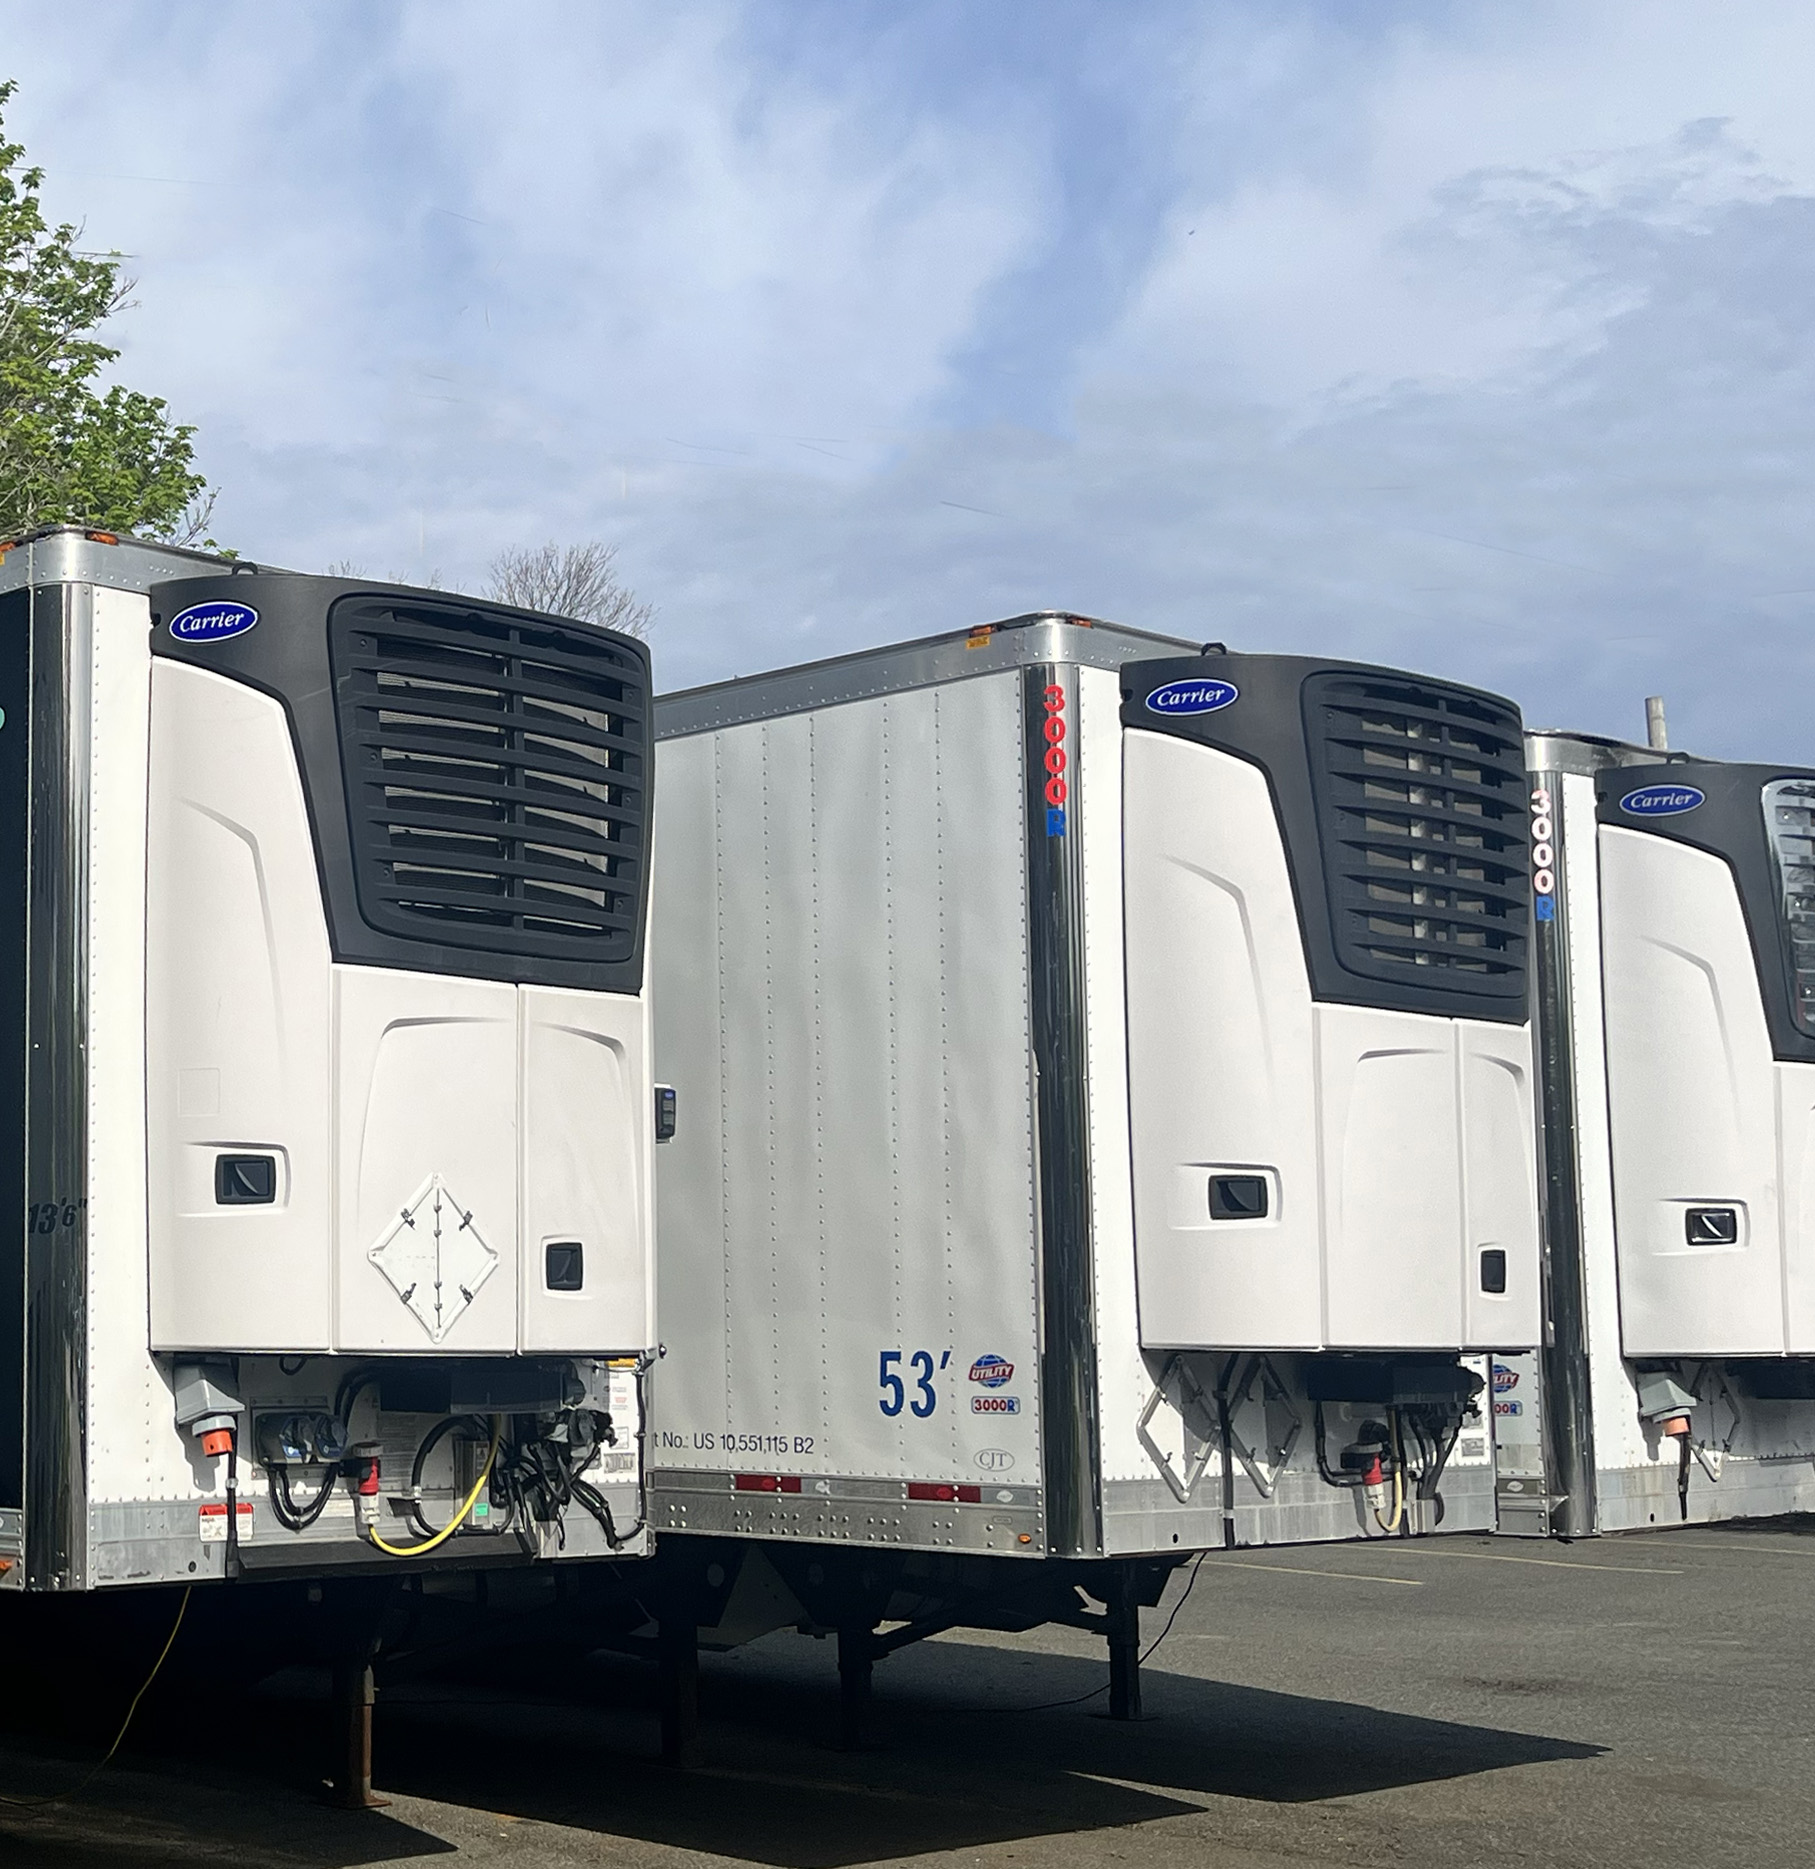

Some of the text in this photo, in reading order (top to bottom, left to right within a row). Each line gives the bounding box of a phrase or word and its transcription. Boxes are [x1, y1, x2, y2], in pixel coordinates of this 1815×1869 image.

[180, 612, 244, 632] Carrier
[1157, 688, 1225, 707] Carrier
[1044, 685, 1066, 837] 3000R
[1631, 793, 1693, 808] Carrier
[971, 1365, 1012, 1379] UTILITY
[879, 1350, 951, 1418] 53'
[974, 1399, 1016, 1412] 3000R
[693, 1432, 715, 1450] US
[720, 1434, 789, 1456] 10,551,115
[794, 1436, 815, 1454] B2
[979, 1451, 1007, 1468] CJT
